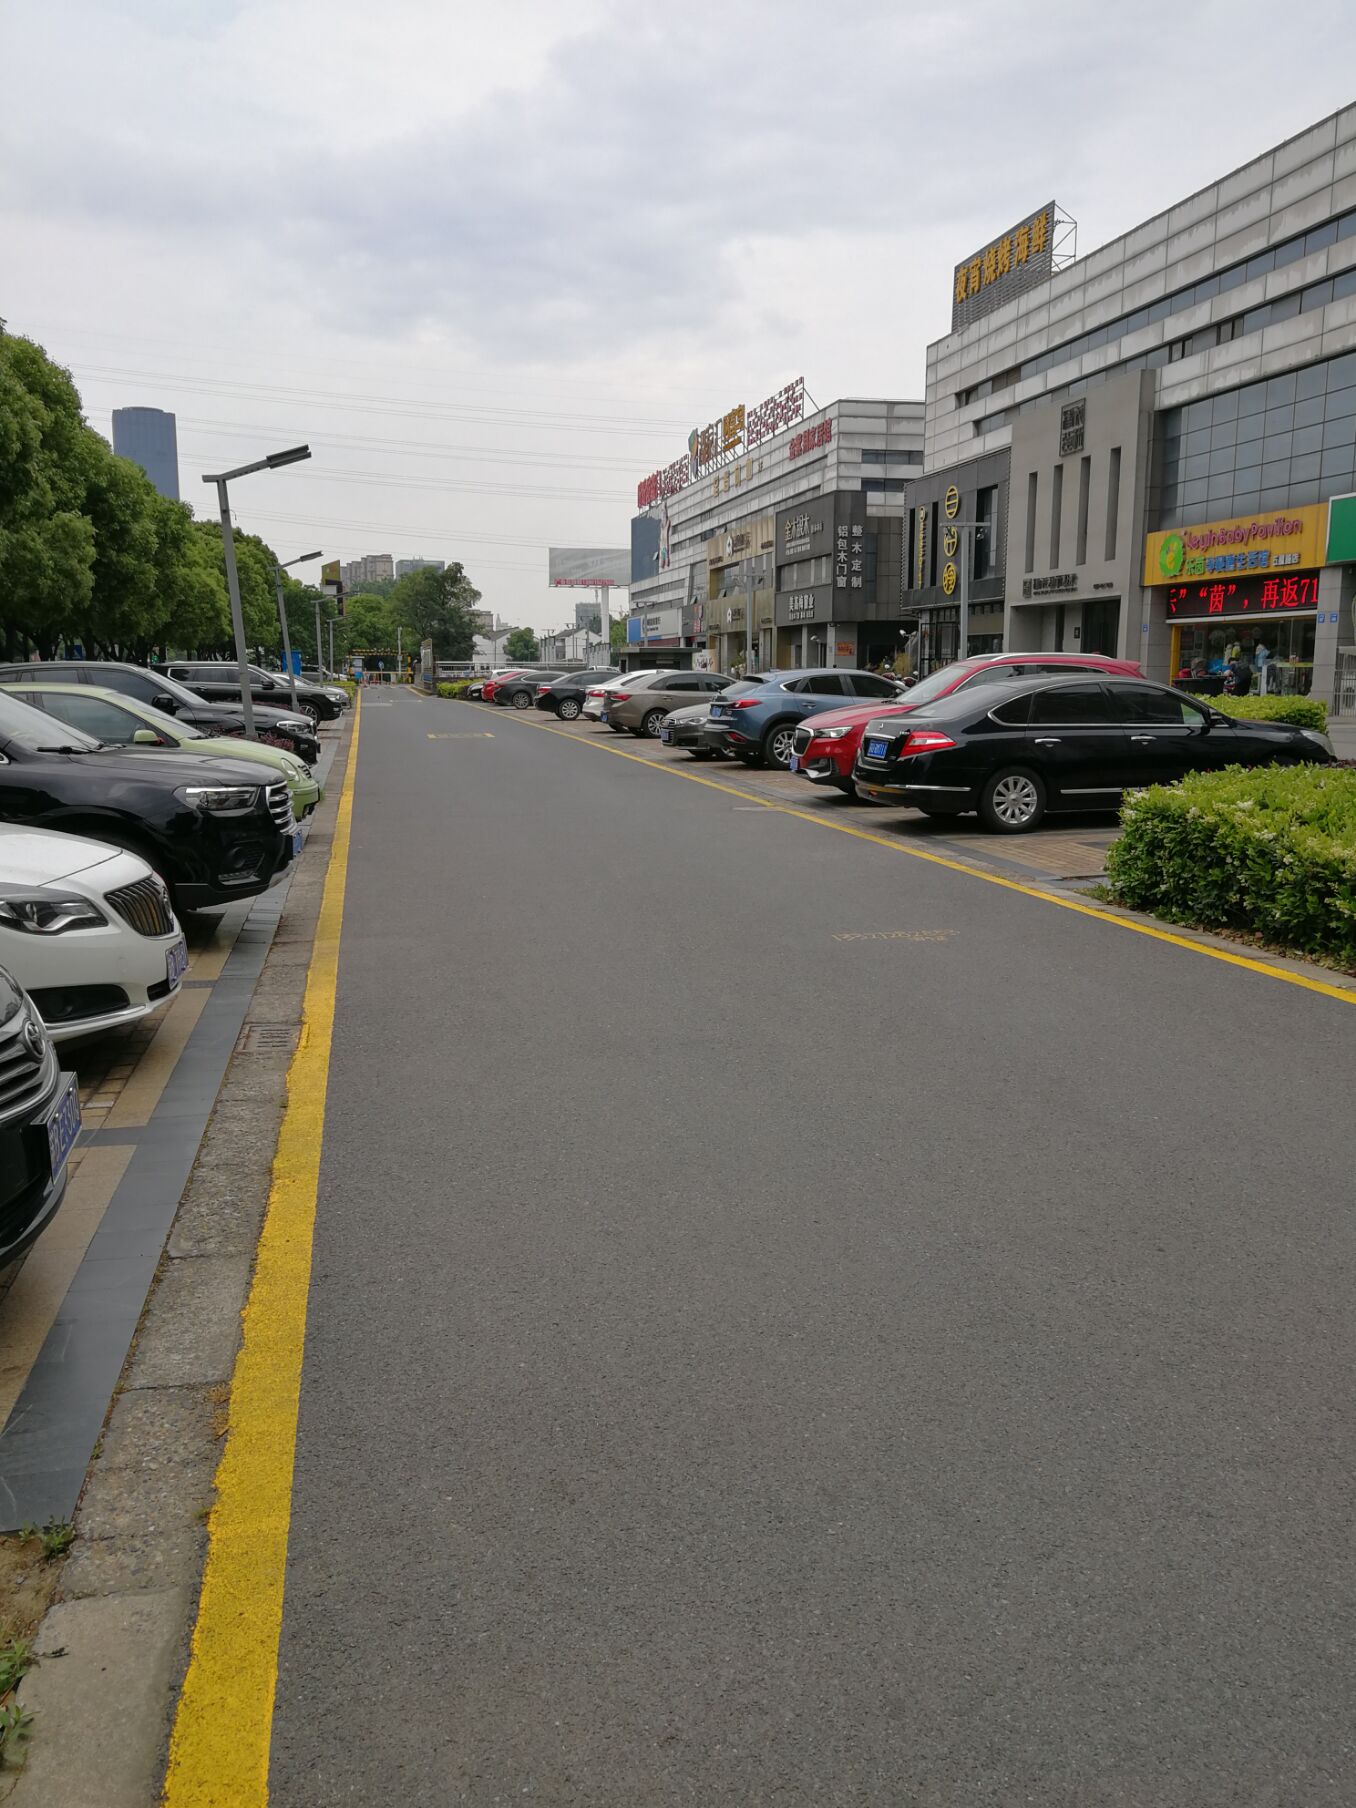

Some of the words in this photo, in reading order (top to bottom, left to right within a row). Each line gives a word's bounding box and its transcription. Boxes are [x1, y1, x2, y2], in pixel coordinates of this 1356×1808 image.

[836, 525, 849, 589] 铝包木门窗
[851, 525, 863, 589] 整木定制
